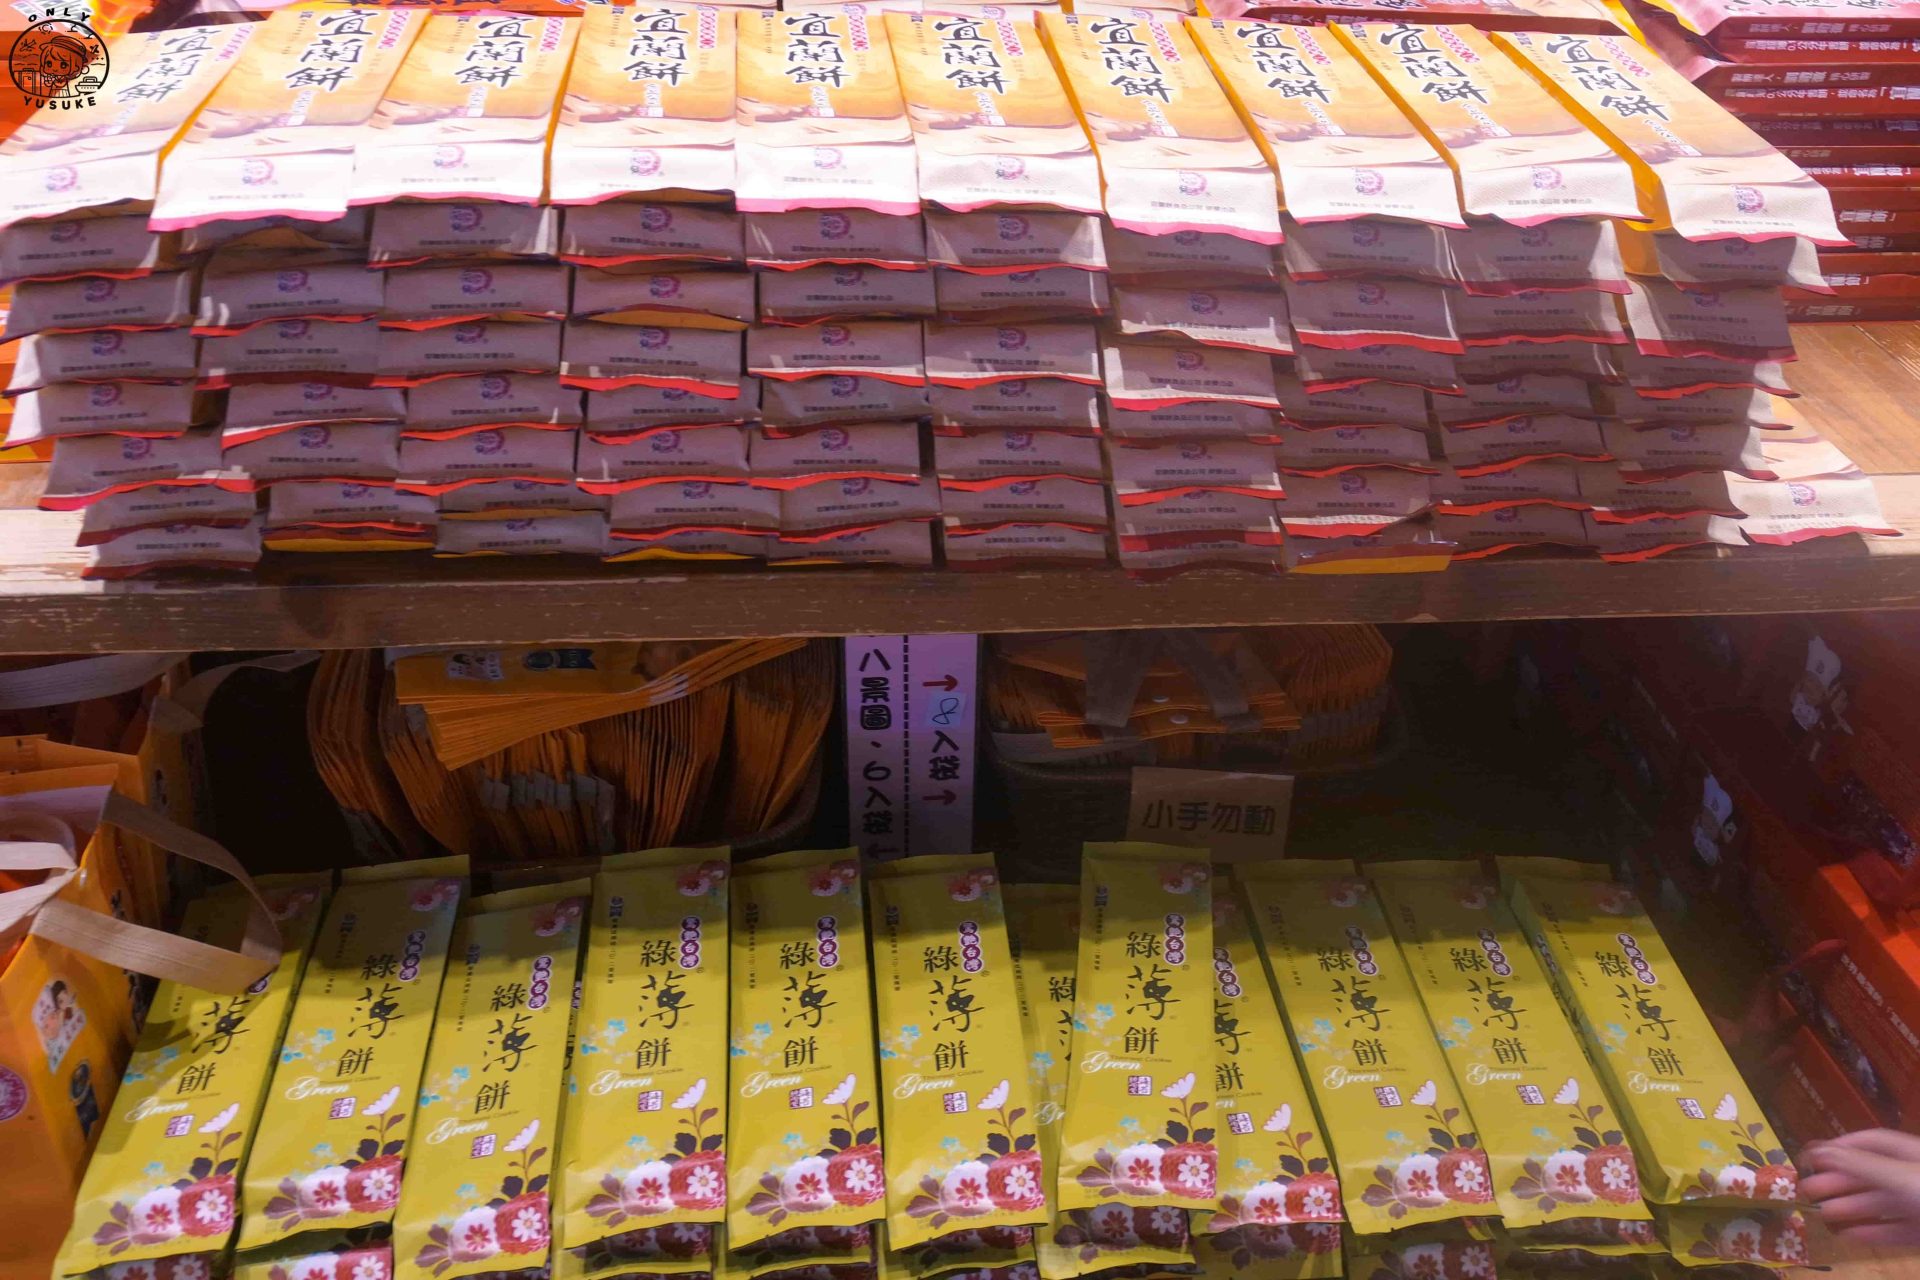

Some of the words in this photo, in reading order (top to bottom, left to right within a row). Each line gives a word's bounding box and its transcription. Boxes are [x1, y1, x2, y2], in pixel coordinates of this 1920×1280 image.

[117, 28, 219, 103] 宜蘭餅
[286, 9, 377, 92] 宜蘭餅
[454, 16, 535, 88] 宜蘭餅
[624, 9, 690, 87] 宜蘭餅
[784, 12, 853, 88] 宜蘭餅
[934, 17, 1010, 95] 宜蘭餅
[1090, 17, 1175, 104] 宜蘭餅
[1237, 23, 1331, 104] 宜蘭餅
[1380, 23, 1488, 104] 宜蘭餅
[1547, 35, 1669, 122] 宜蘭餅
[929, 697, 960, 780] 8入袋
[1141, 799, 1276, 835] 小手勿動
[176, 996, 251, 1095] 薄餅
[589, 1069, 652, 1096] Green
[1080, 1050, 1142, 1073] Green
[1214, 998, 1252, 1092] 薄餅
[1324, 1065, 1381, 1089] Green
[1465, 1062, 1523, 1085] Green
[1627, 1071, 1682, 1094] Green
[285, 1076, 350, 1100] Green
[741, 1071, 803, 1098] Green
[893, 1073, 955, 1099] Green
[426, 1118, 489, 1144] Green
